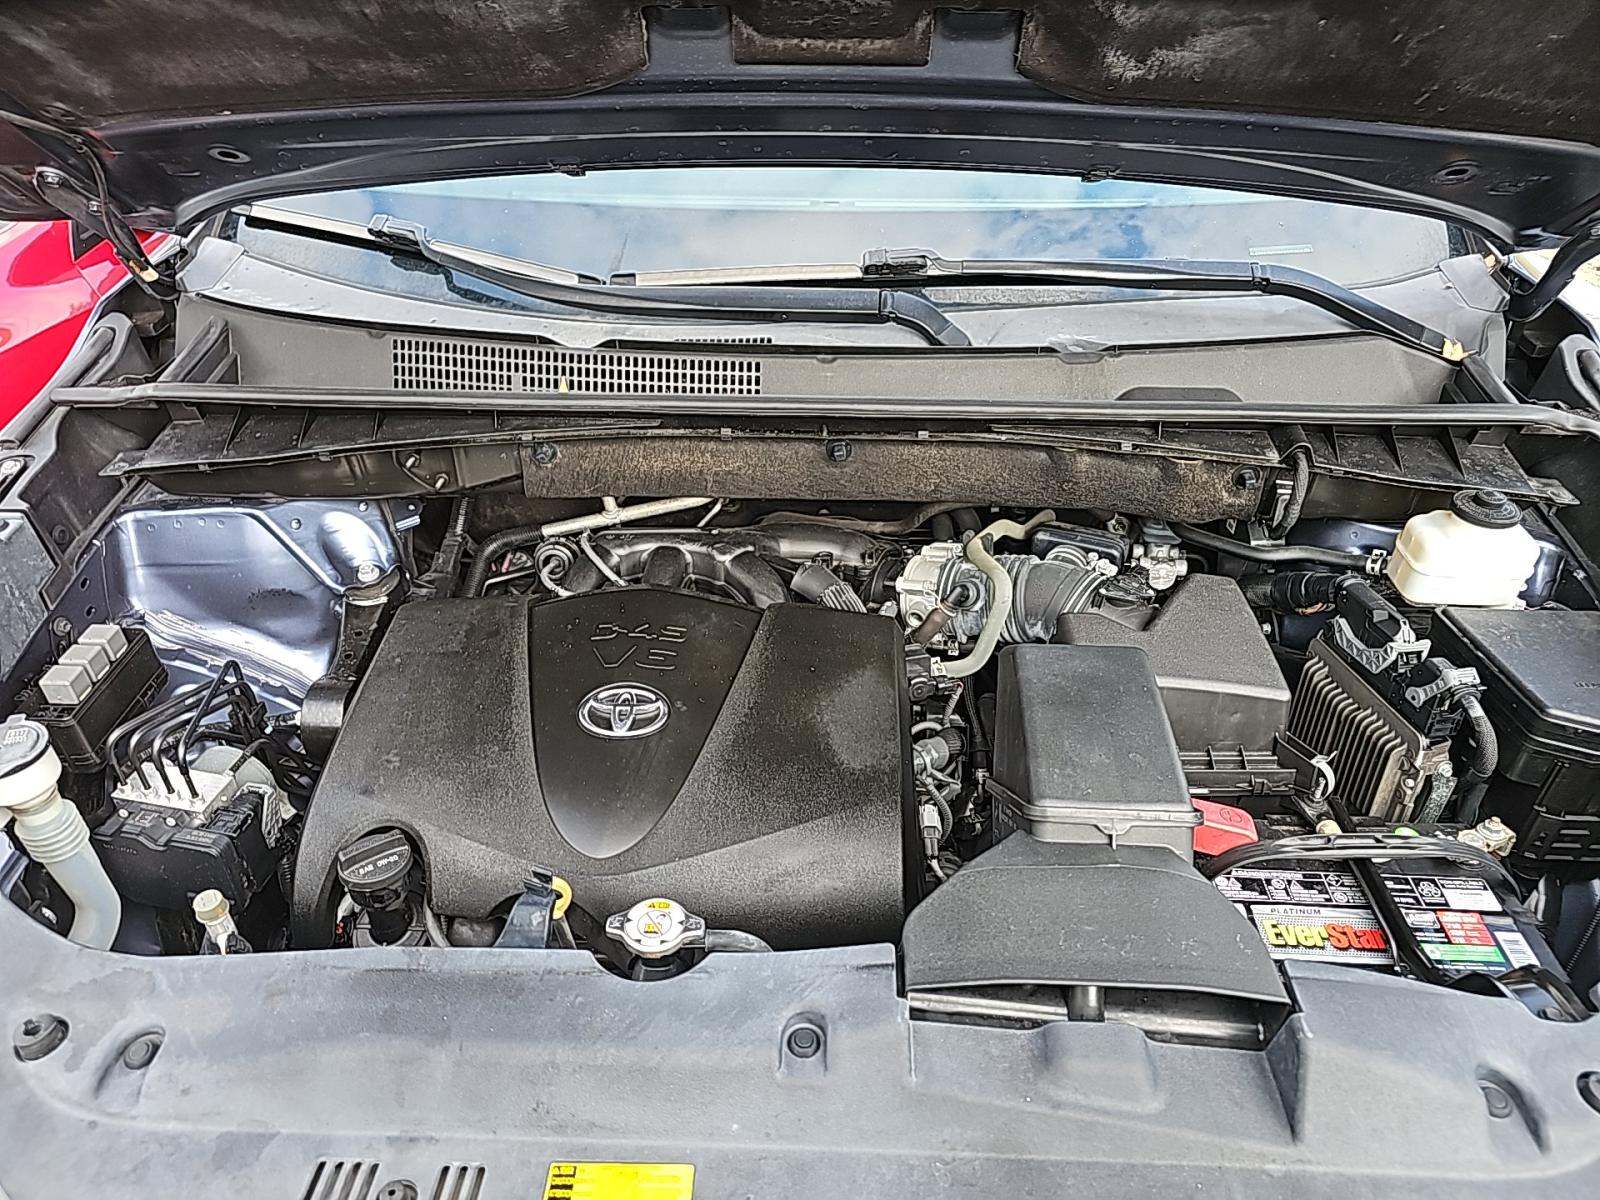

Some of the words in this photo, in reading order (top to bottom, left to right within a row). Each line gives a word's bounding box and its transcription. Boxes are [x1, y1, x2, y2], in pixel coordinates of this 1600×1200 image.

[592, 645, 678, 670] V6
[1270, 907, 1322, 916] PLATINUM
[1261, 919, 1388, 950] EverStar
